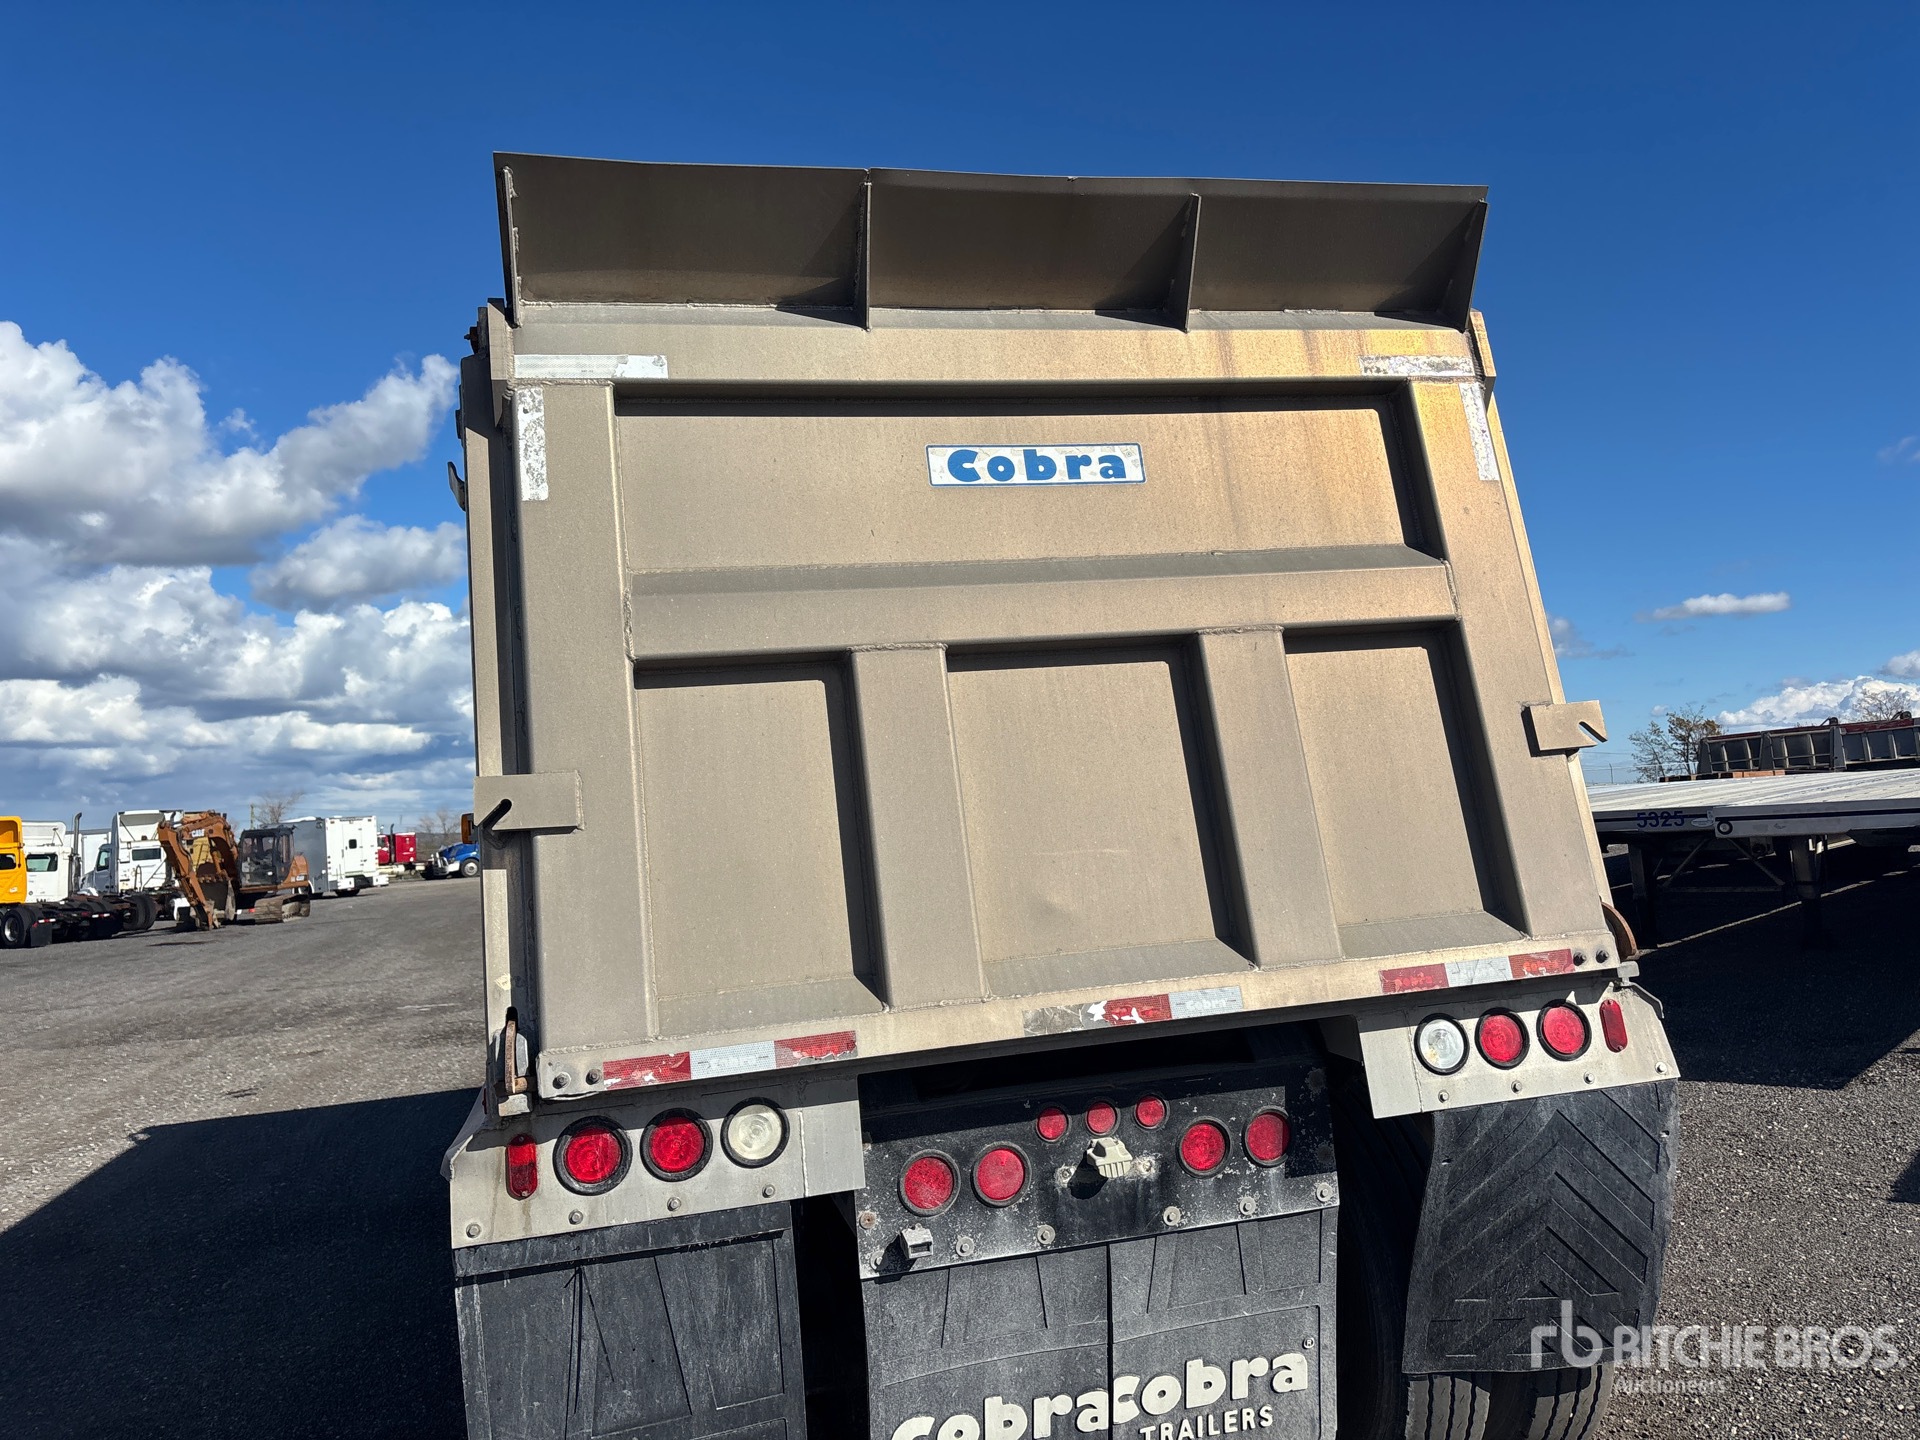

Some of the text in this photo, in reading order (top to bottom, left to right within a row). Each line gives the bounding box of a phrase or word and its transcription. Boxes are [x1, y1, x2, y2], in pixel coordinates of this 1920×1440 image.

[947, 448, 1127, 483] Cobra
[1636, 810, 1685, 828] 5325
[1139, 1404, 1274, 1440] TRAILERS
